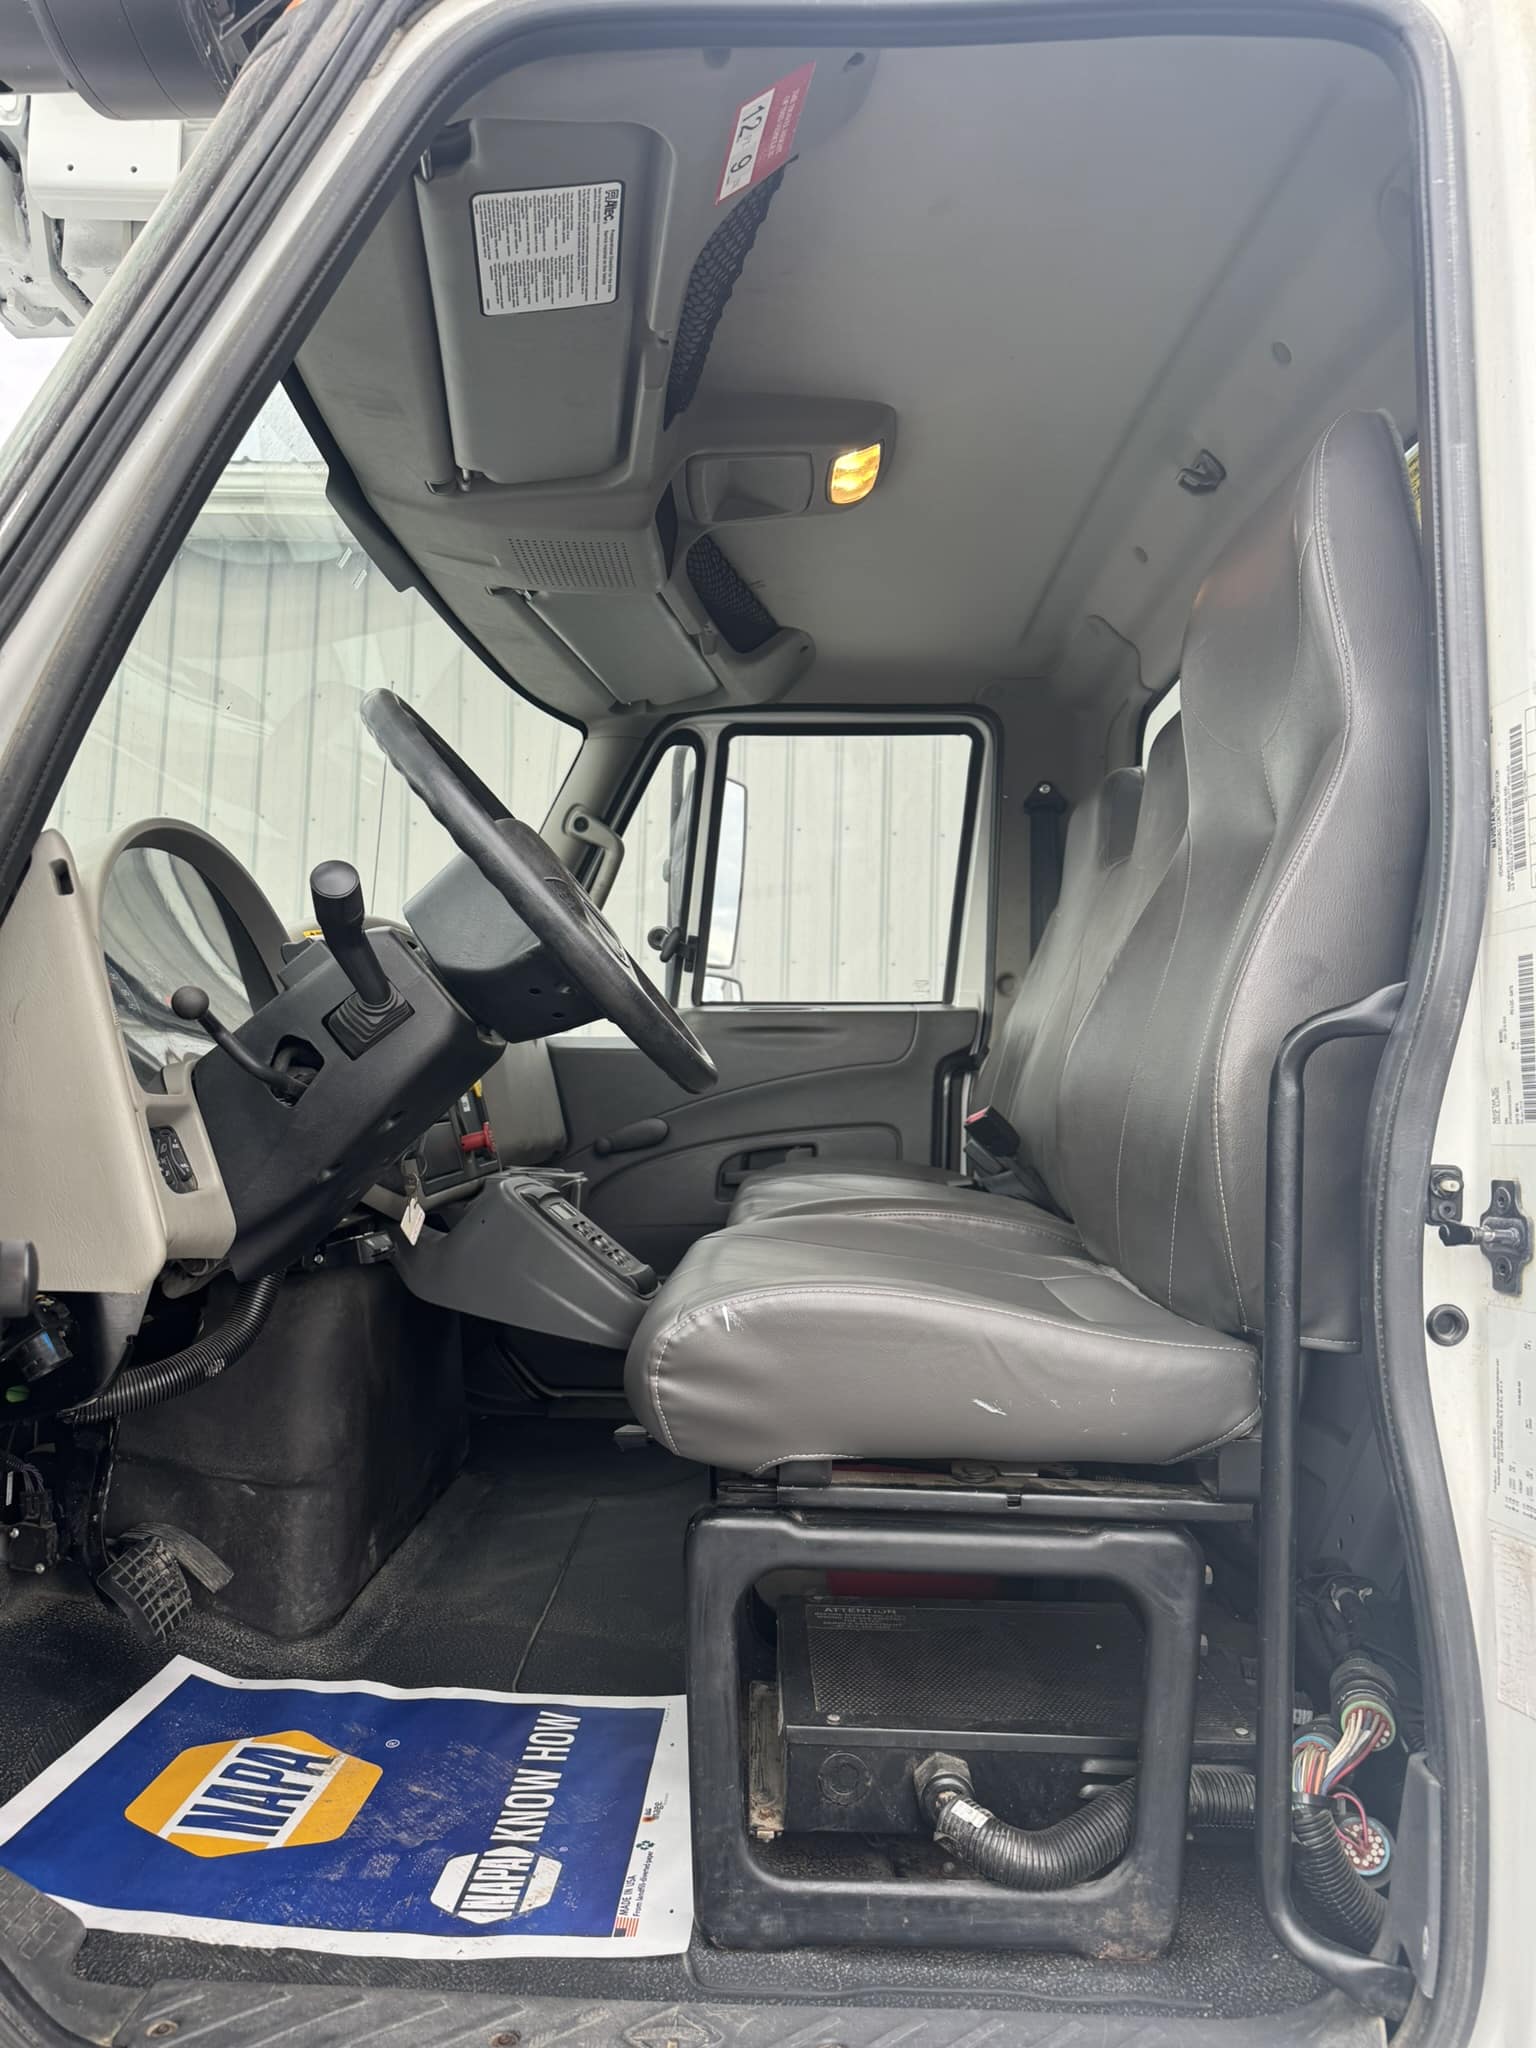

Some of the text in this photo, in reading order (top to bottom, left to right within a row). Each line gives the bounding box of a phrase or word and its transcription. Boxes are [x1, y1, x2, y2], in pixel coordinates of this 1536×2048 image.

[738, 105, 765, 138] 12
[730, 154, 753, 174] 9
[176, 1746, 336, 1837] NAPA
[490, 1710, 581, 1841] KNOW HOW
[460, 1856, 536, 1910] NAPA
[619, 1874, 637, 1916] MADE IN USA
[633, 1899, 642, 1917] From
